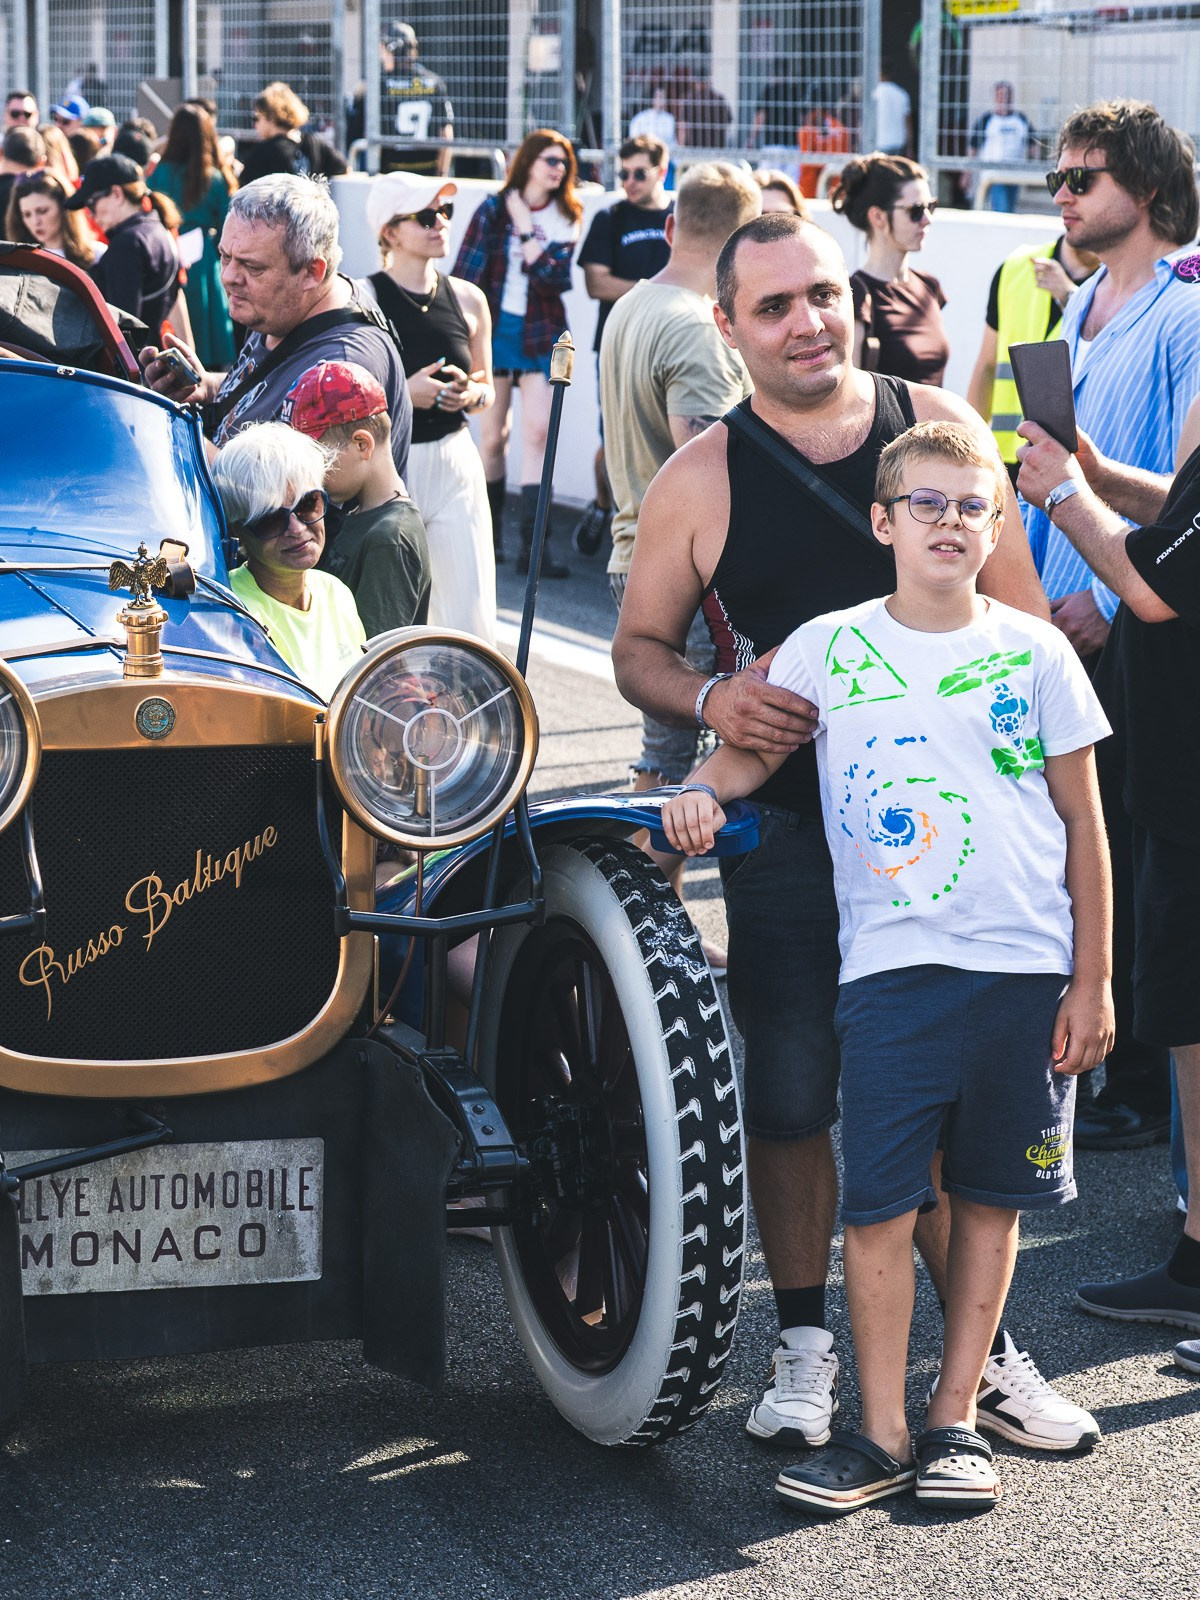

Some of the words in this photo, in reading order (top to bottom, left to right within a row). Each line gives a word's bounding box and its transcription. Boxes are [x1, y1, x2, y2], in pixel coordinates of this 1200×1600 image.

[396, 100, 433, 141] 9
[1156, 547, 1174, 564] WOLF
[1173, 527, 1194, 548] BLACK
[18, 924, 128, 1022] Russo
[125, 825, 278, 952] Baltique
[19, 1178, 90, 1223] LLYE
[107, 1166, 315, 1214] AUTOMOBILE
[21, 1222, 267, 1270] MONACO
